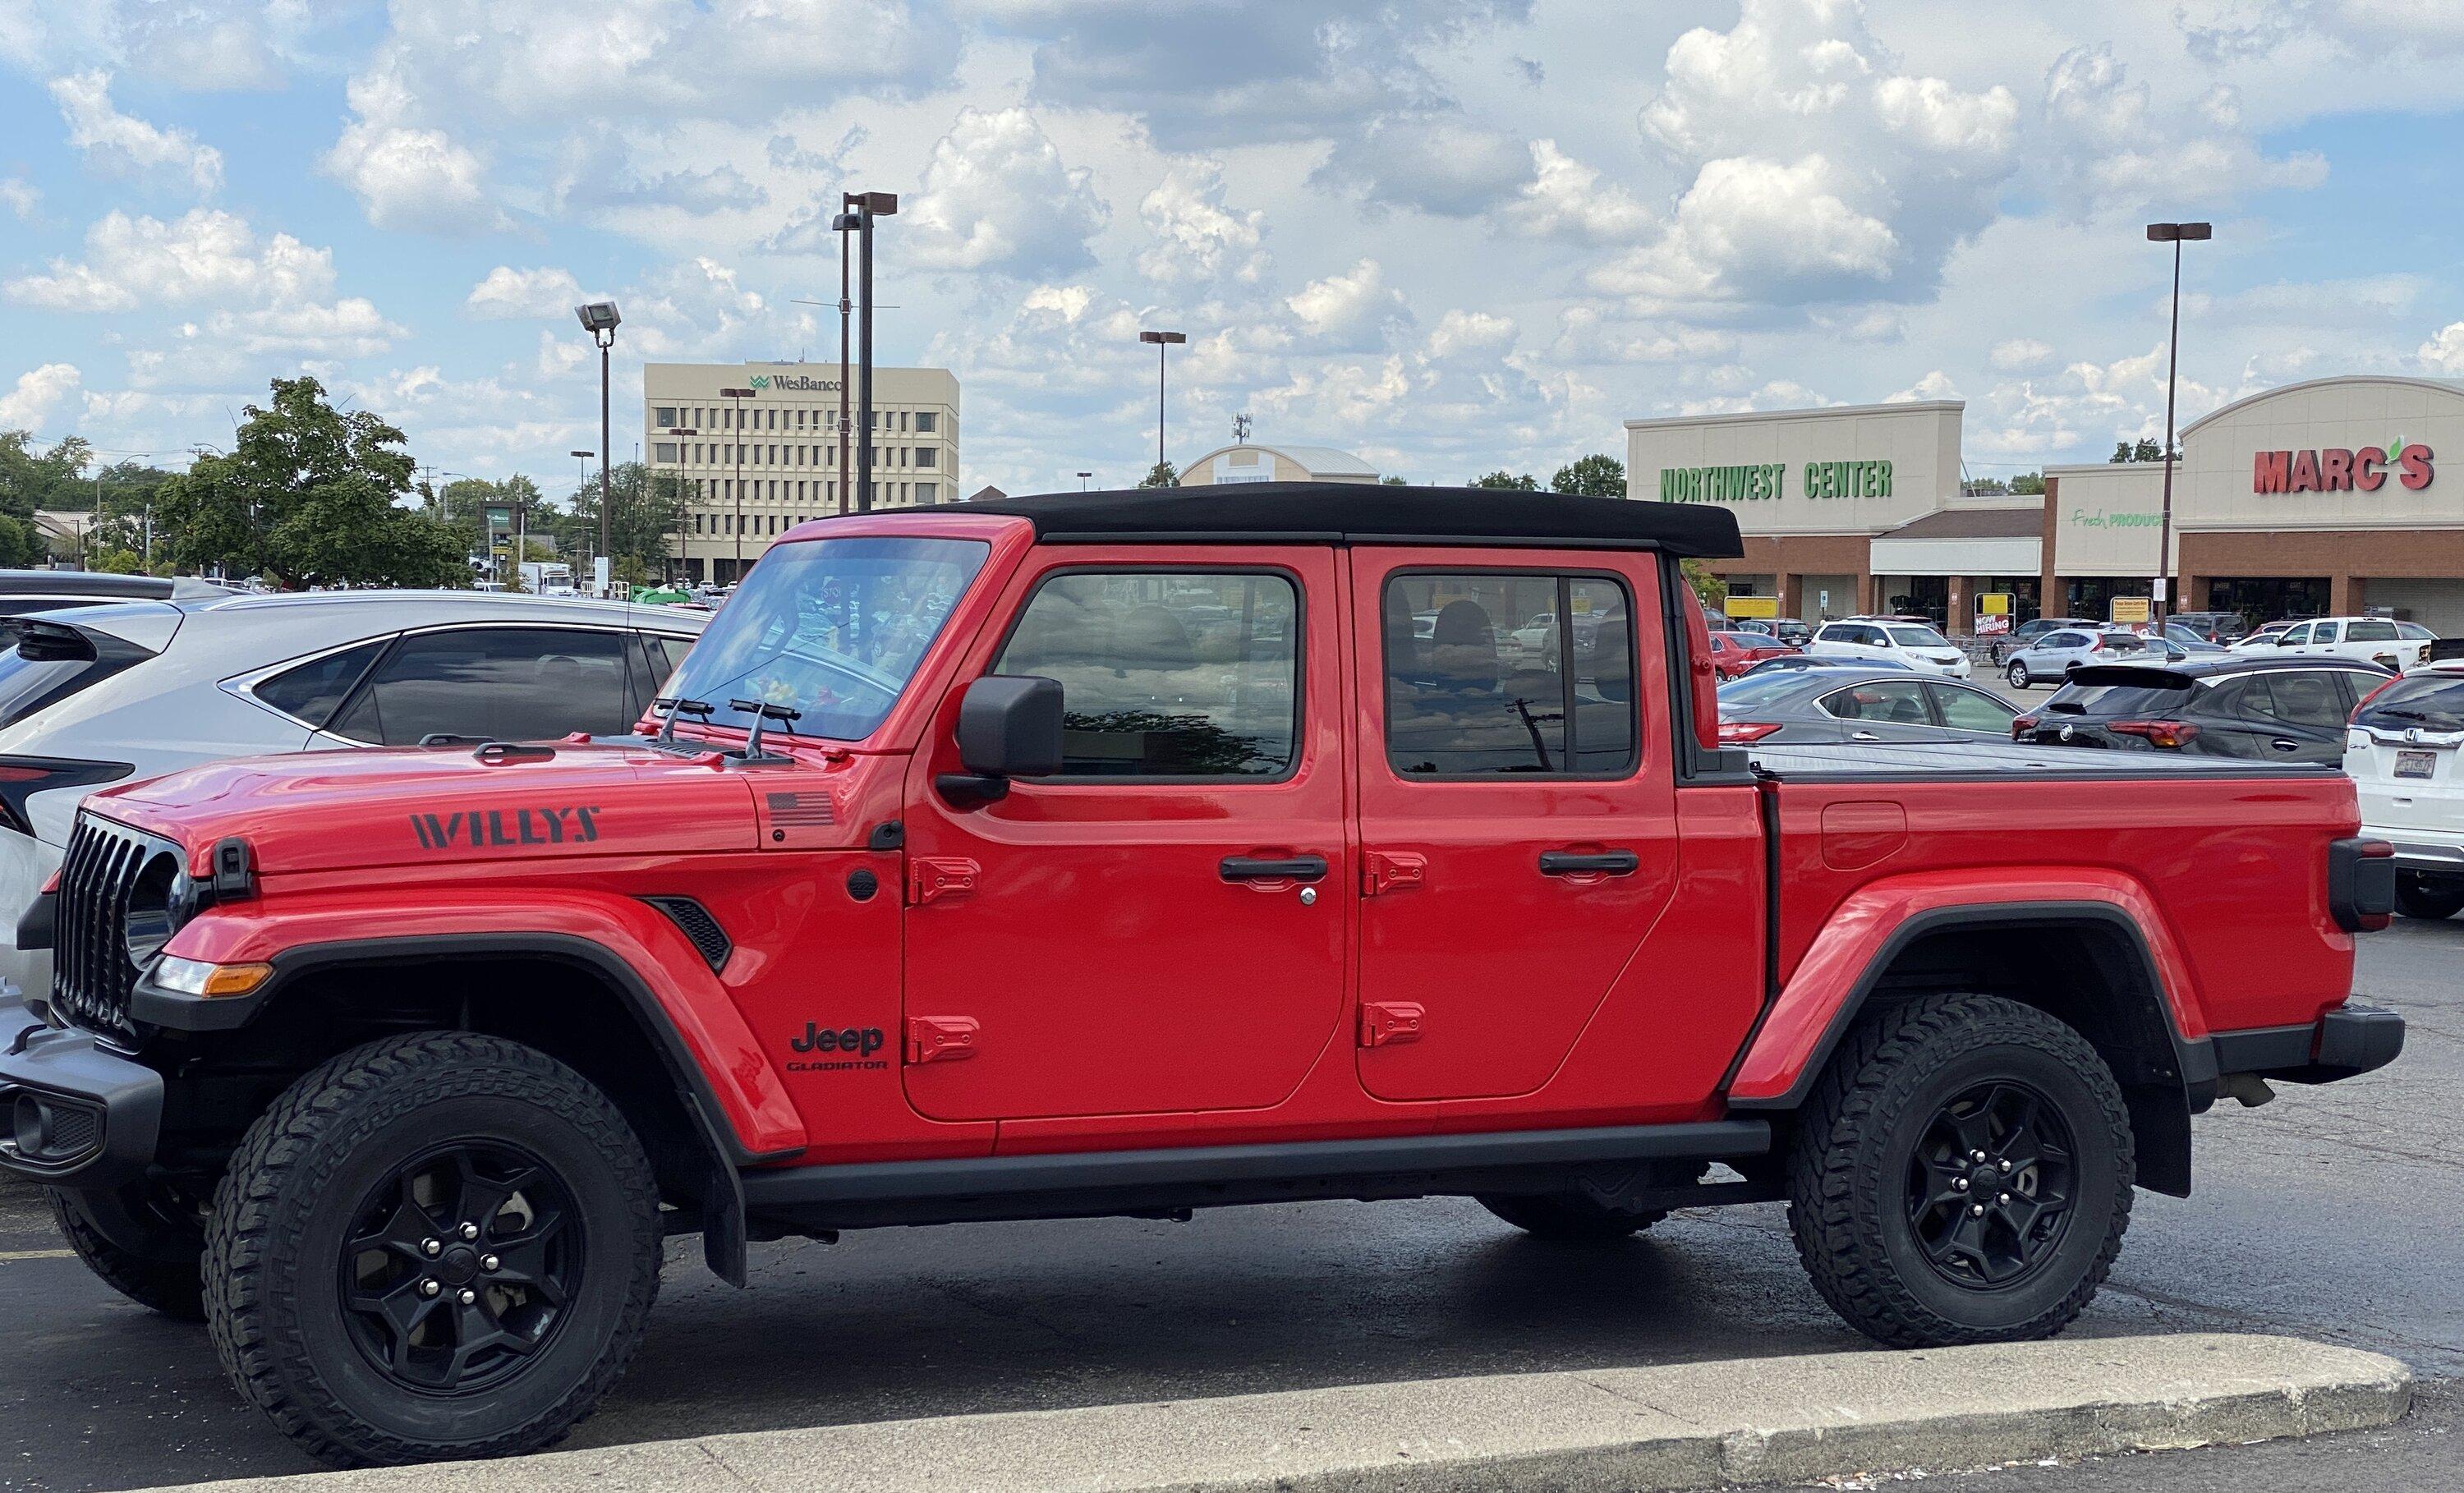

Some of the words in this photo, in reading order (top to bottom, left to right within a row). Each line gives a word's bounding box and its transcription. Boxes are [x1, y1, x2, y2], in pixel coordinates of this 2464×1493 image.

[773, 375, 841, 391] WesBanco
[2254, 435, 2434, 494] MARC'S
[1660, 464, 1786, 503] NORTHWEST
[1804, 460, 1892, 498] CENTER
[2071, 508, 2108, 529] Fresh
[2109, 513, 2163, 526] PRODUC
[1975, 615, 1996, 627] NOW
[1975, 619, 2010, 635] HIRING
[410, 806, 600, 849] WILLYS
[791, 1021, 884, 1057] Jeep
[786, 1060, 888, 1071] GLADIATOR
